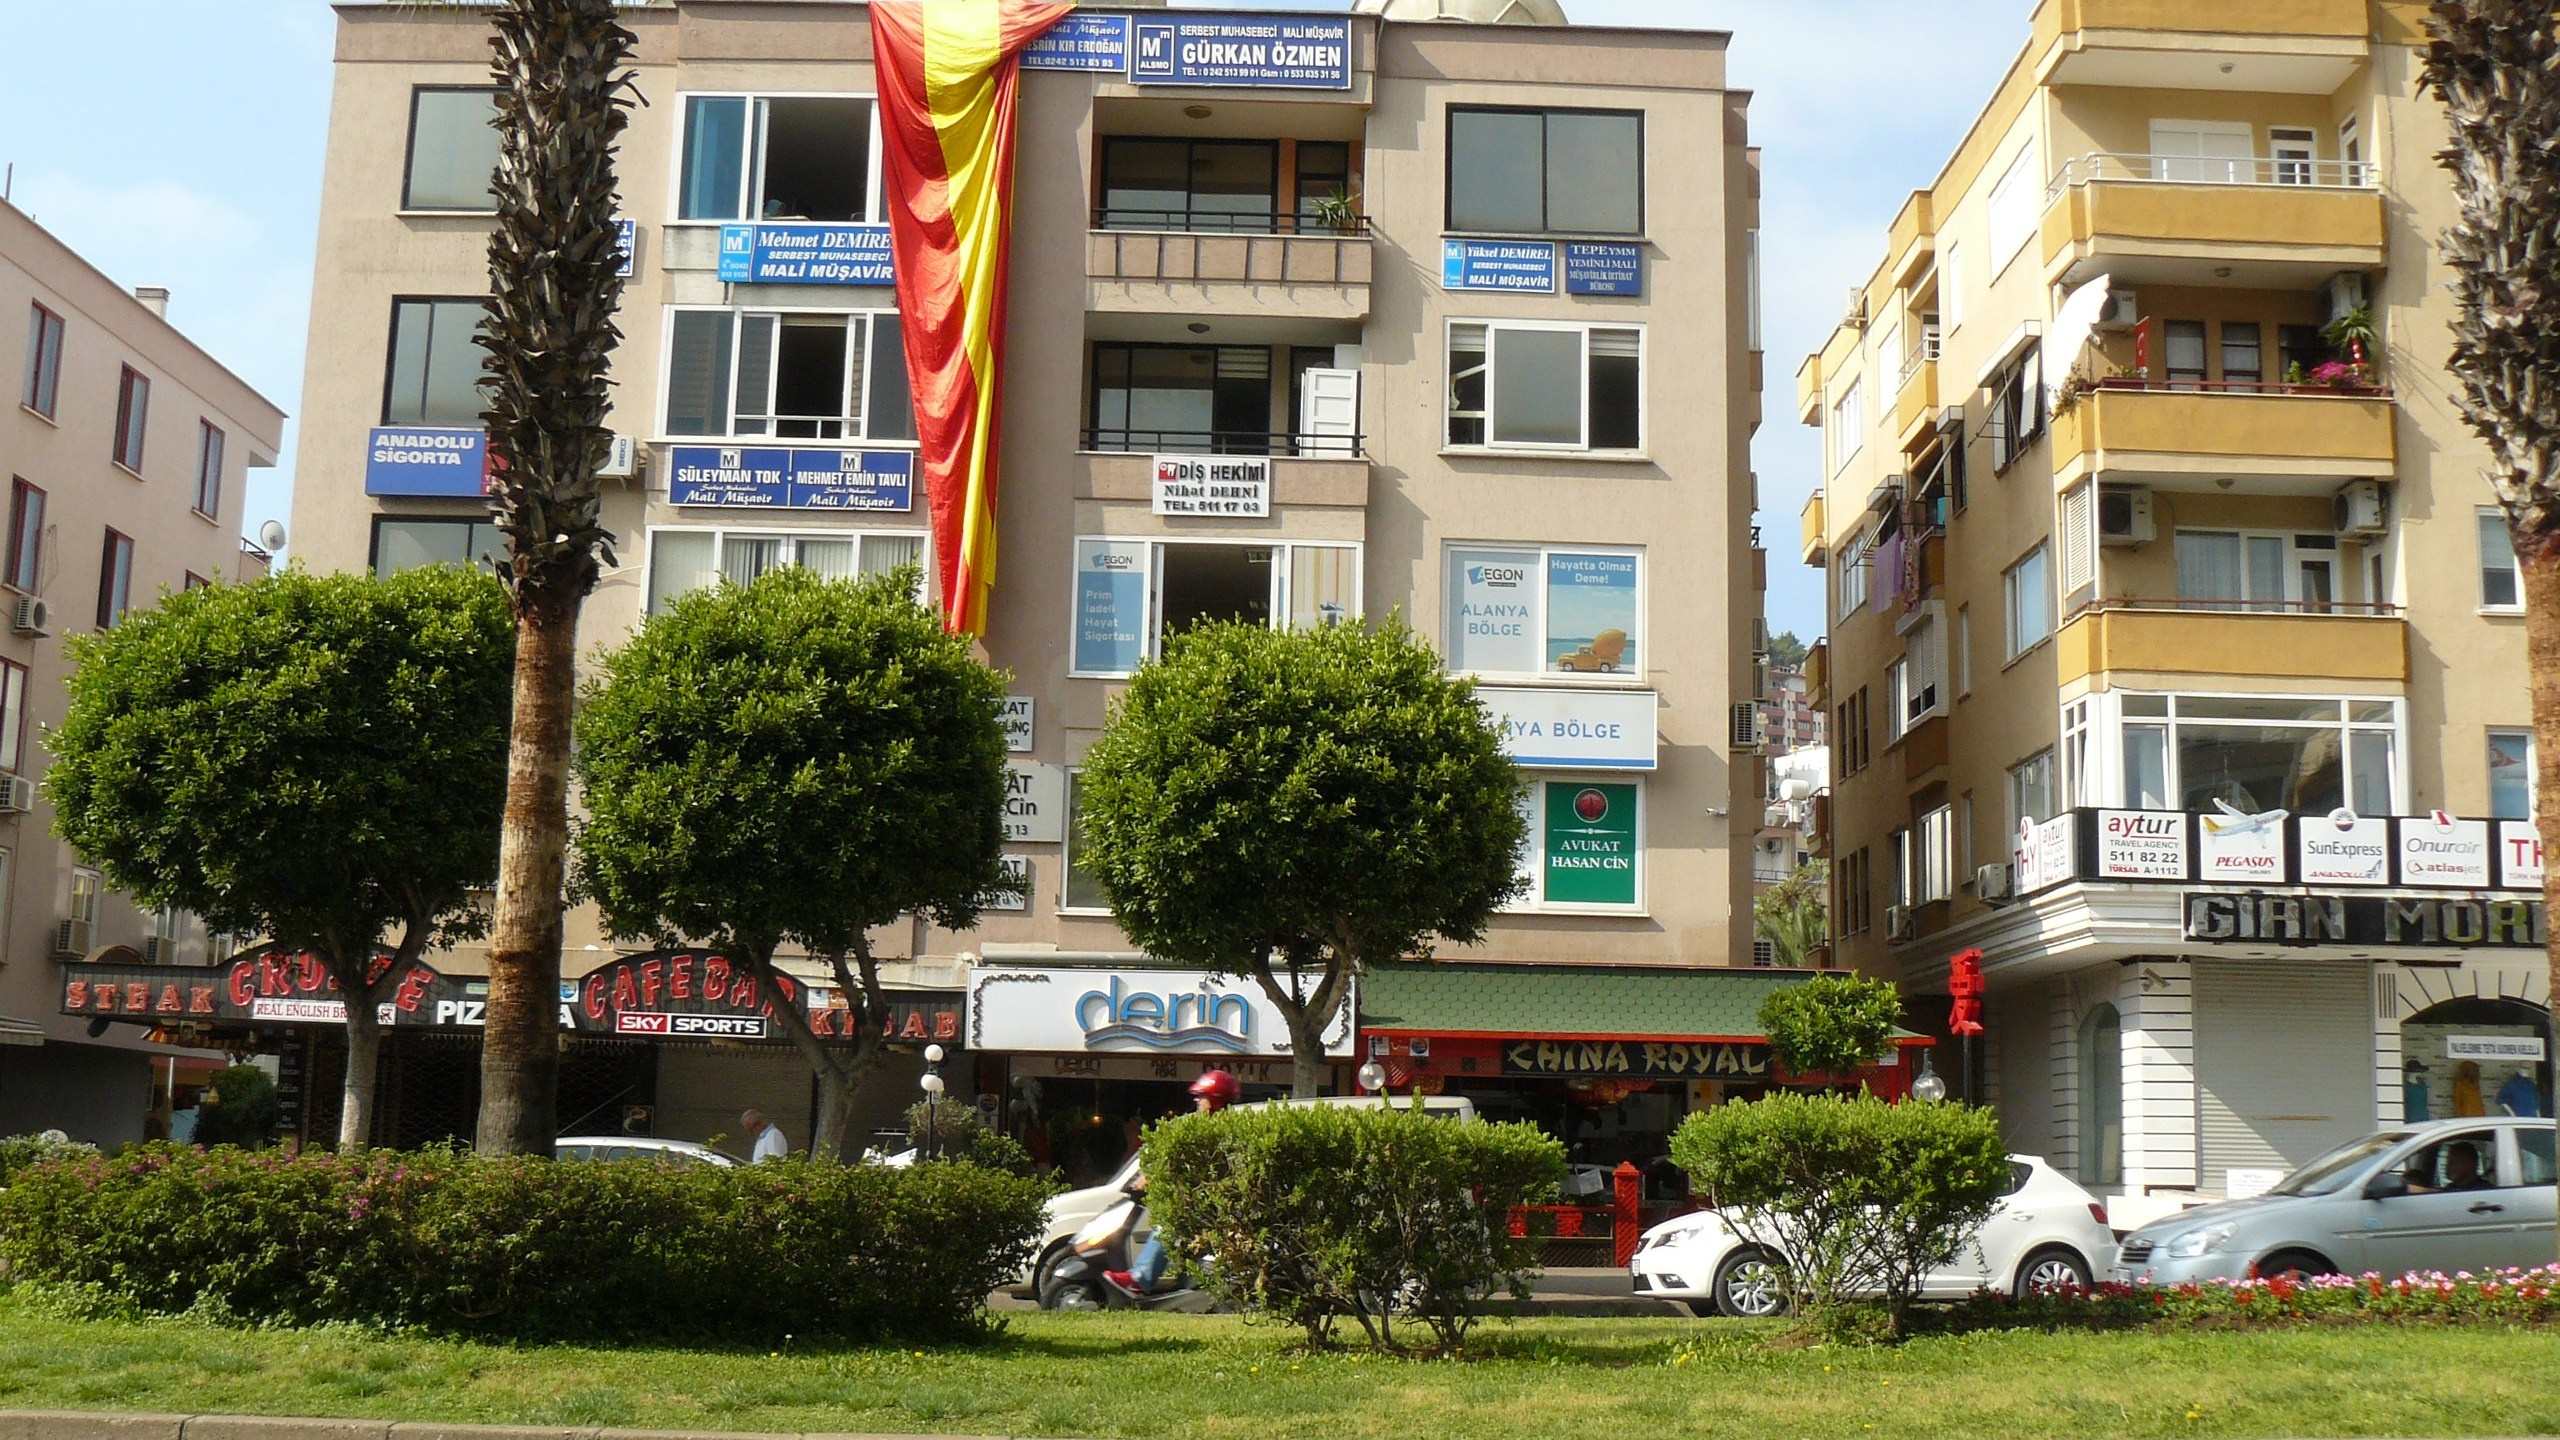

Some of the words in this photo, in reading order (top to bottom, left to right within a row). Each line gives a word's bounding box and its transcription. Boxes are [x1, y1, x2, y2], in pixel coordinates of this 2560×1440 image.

[1180, 25, 1219, 37] SERBEST
[1221, 25, 1277, 38] MUHASEBECİ
[1283, 25, 1304, 38] MALİ
[1305, 26, 1344, 41] MÜŞAVİR
[1059, 40, 1075, 52] KIR
[1078, 39, 1122, 54] ERDOĞAN
[1182, 39, 1266, 65] GÜRKAN
[1272, 41, 1341, 67] ÖZMEN
[1182, 67, 1197, 76] TEL
[1209, 68, 1223, 76] 242
[1225, 68, 1238, 76] 513
[1260, 69, 1278, 77] Gsm
[757, 231, 818, 248] Mehmet
[822, 229, 893, 249] DEMİRE
[768, 251, 817, 260] SERBEST
[819, 252, 889, 261] MUHASEBECİ
[1467, 246, 1498, 257] Yüksel
[1500, 246, 1551, 260] DEMİREL
[1570, 244, 1607, 255] TEPE
[1609, 247, 1636, 256] YMM
[760, 262, 806, 277] MALİ
[810, 263, 893, 280] MÜŞAVİR
[1503, 262, 1546, 271] MUHASEBECİ
[1569, 258, 1610, 268] YEMİNLİ
[1612, 259, 1637, 269] MALİ
[1469, 274, 1497, 285] MALİ
[1499, 275, 1549, 287] MÜŞAVİR
[375, 434, 475, 449] ANADOLU
[374, 448, 461, 465] SİGORTA
[678, 465, 751, 483] SÜLEYMAN
[755, 470, 781, 484] TOK
[797, 471, 843, 485] MEHMET
[846, 469, 875, 486] EMİN
[878, 473, 906, 487] TAVLI
[1180, 461, 1205, 483] DİŞ
[1210, 462, 1265, 481] HEKİMİ
[684, 490, 717, 503] Mali
[721, 491, 772, 506] Müşavir
[1164, 485, 1205, 497] Nihat
[805, 493, 838, 507] Mali
[843, 494, 894, 509] Müşavir
[1164, 501, 1195, 511] TEL:
[1198, 501, 1220, 512] 511
[1224, 502, 1239, 512] 17
[1243, 502, 1260, 512] 03
[1552, 560, 1595, 572] Hayatta
[1599, 561, 1633, 572] Olmaz
[1575, 573, 1609, 584] Deme!
[1086, 590, 1112, 600] Prim
[1462, 604, 1529, 618] ALANYA
[1085, 617, 1119, 629] Hayat
[1469, 620, 1522, 636] BÖLGE
[1085, 631, 1135, 642] Sigortası
[1553, 719, 1620, 738] BÖLGE
[1007, 797, 1037, 815] Cin
[1015, 824, 1028, 835] 13
[2108, 814, 2177, 837] aytur
[1561, 840, 1620, 852] AVUKAT
[2110, 840, 2141, 848] TRAVEL
[2144, 840, 2179, 849] AGENCY
[2307, 840, 2382, 858] SunExpress
[2407, 838, 2480, 854] Onurair
[1552, 856, 1600, 868] HASAN
[1603, 856, 1628, 869] CİN
[2014, 844, 2037, 878] THY
[2110, 851, 2134, 861] 511
[2140, 852, 2157, 862] 82
[2162, 853, 2178, 863] 22
[2216, 856, 2276, 868] PEGASUS
[2109, 864, 2138, 873] TÜRSAB
[2144, 867, 2178, 875] A-1112
[2426, 863, 2482, 875] atlasjet
[585, 955, 693, 1020] CAFE
[67, 980, 215, 1014] STEAK
[1075, 974, 1250, 1034] derin
[256, 1003, 282, 1016] REAL
[286, 1005, 330, 1018] ENGLISH
[621, 1016, 664, 1030] SKY
[675, 1018, 760, 1034] SPORTS
[1508, 1041, 1629, 1073] CHINA
[1642, 1041, 1767, 1075] ROYAL
